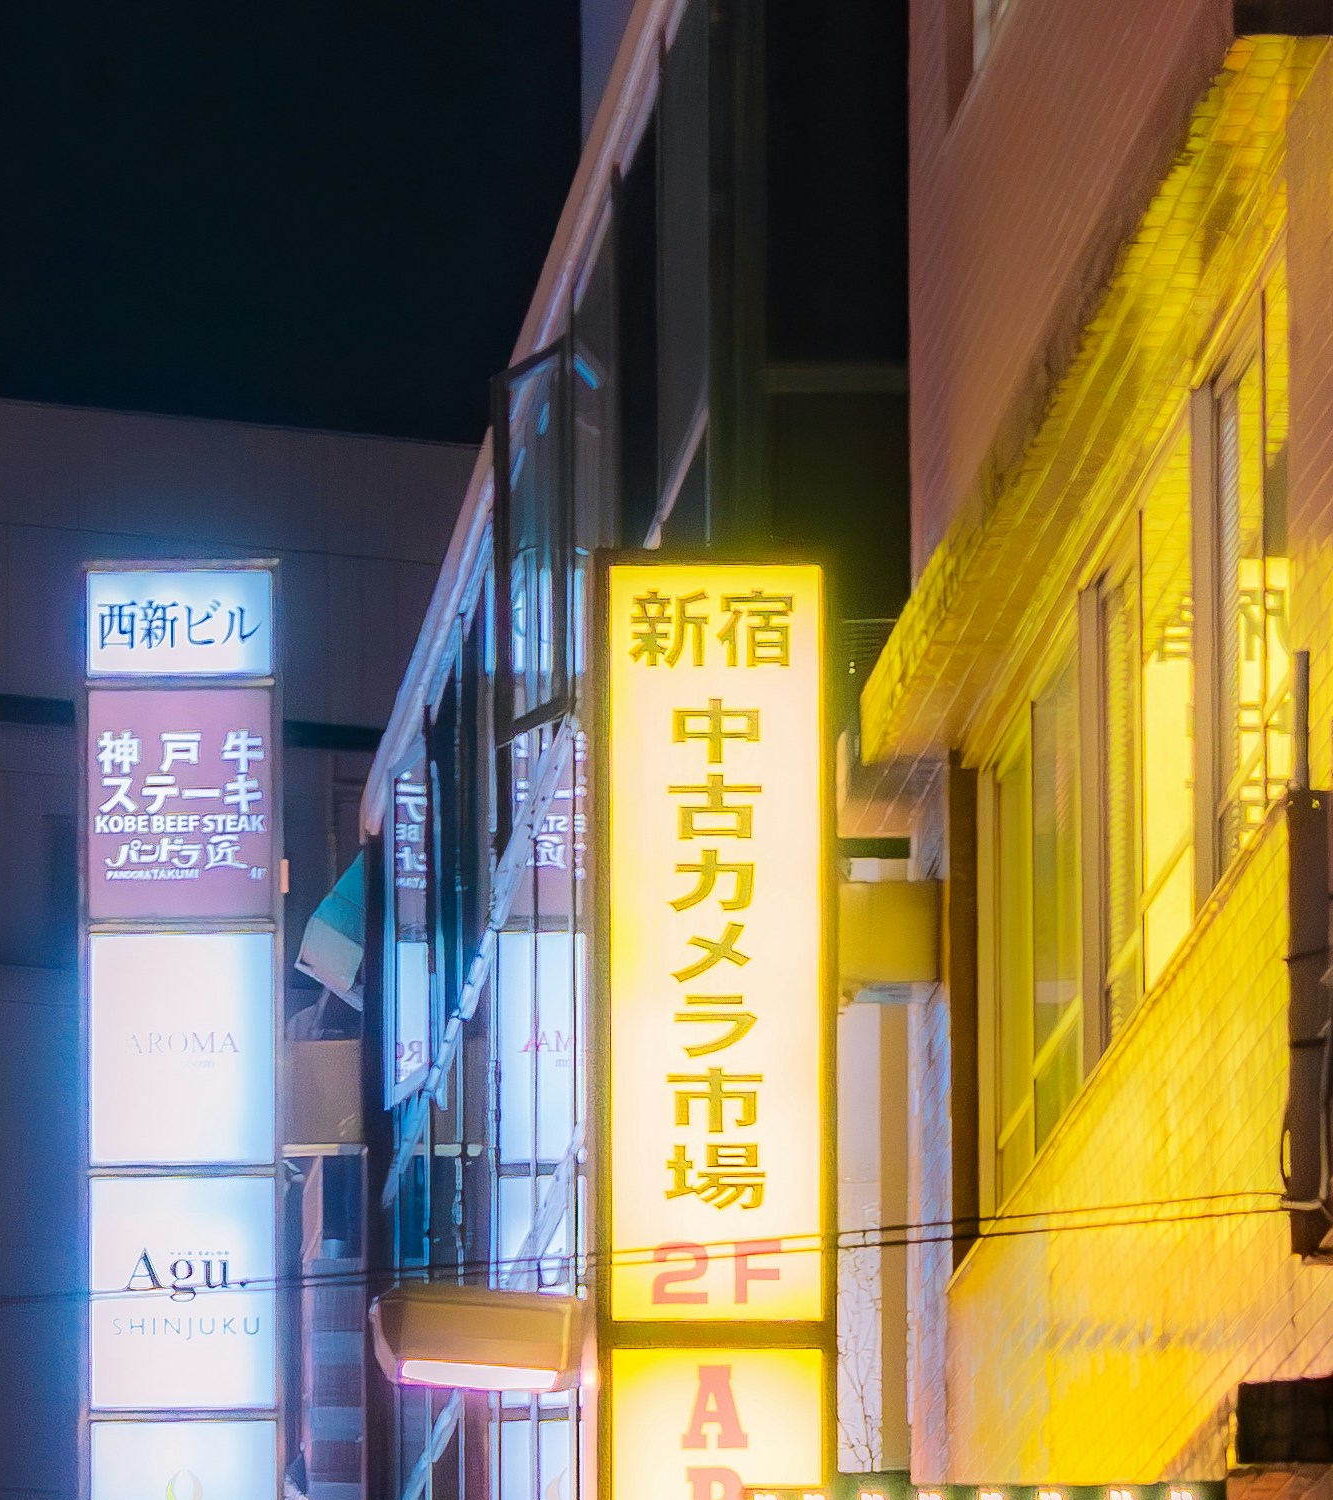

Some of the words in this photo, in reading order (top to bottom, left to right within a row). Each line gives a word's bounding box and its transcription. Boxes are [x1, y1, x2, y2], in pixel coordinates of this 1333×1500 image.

[98, 599, 262, 650] 西新ビル
[629, 588, 796, 668] 新宿
[97, 730, 265, 774] 神戸牛
[99, 774, 264, 814] ステーキ
[94, 814, 149, 834] KOBE
[151, 814, 200, 834] BEEF
[202, 814, 265, 834] STEAK
[104, 838, 201, 867] パンドラ
[666, 697, 767, 1210] 中古カメラ市場
[127, 1030, 241, 1056] AROMA
[651, 1240, 783, 1306] 2F
[112, 1316, 261, 1341] SHINJUKU
